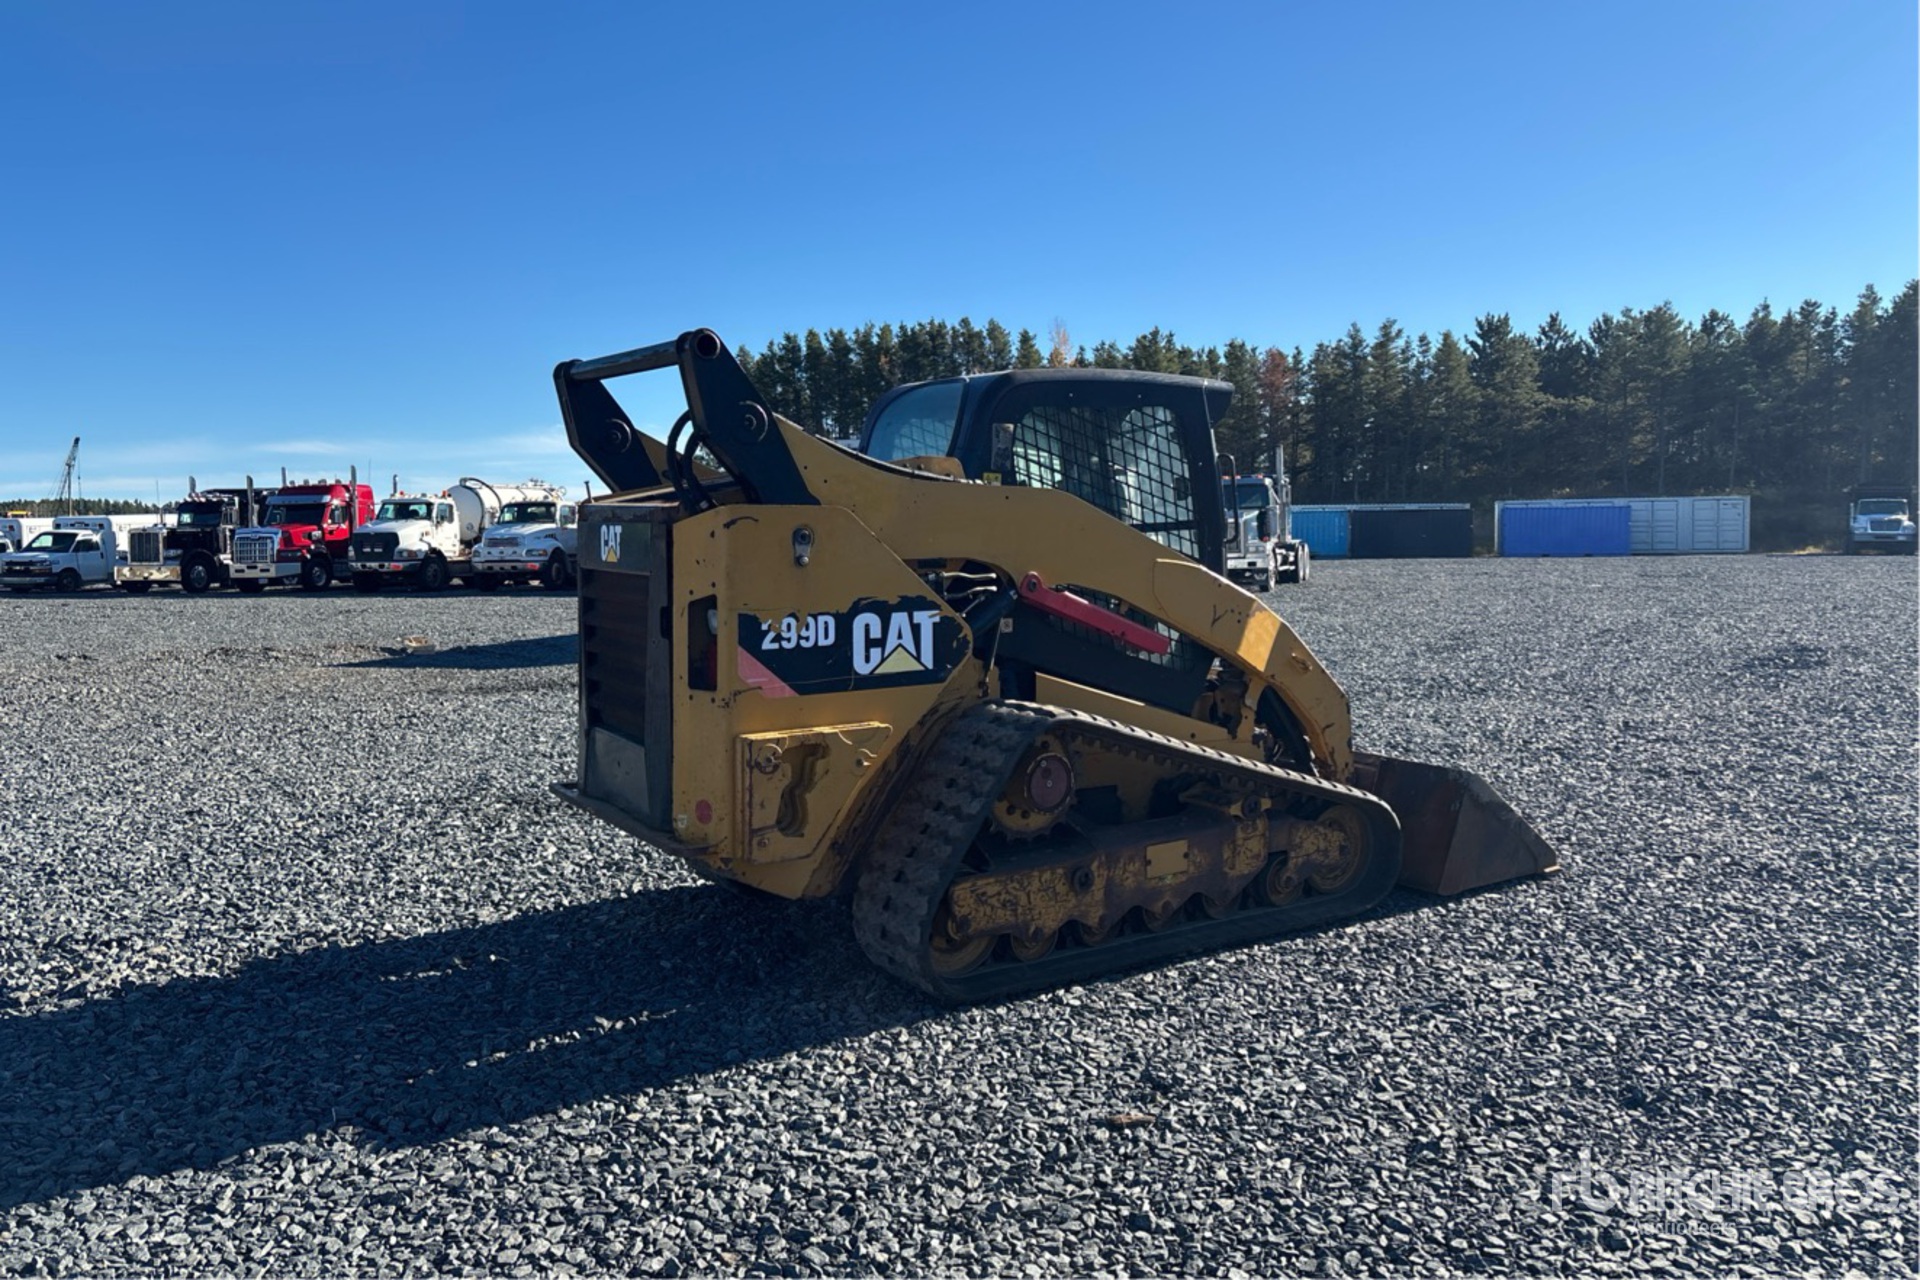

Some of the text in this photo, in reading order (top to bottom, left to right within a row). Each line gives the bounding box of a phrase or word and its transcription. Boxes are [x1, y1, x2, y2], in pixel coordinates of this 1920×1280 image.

[600, 524, 622, 562] CAT
[760, 614, 836, 651] 299D
[852, 610, 941, 676] CAT
